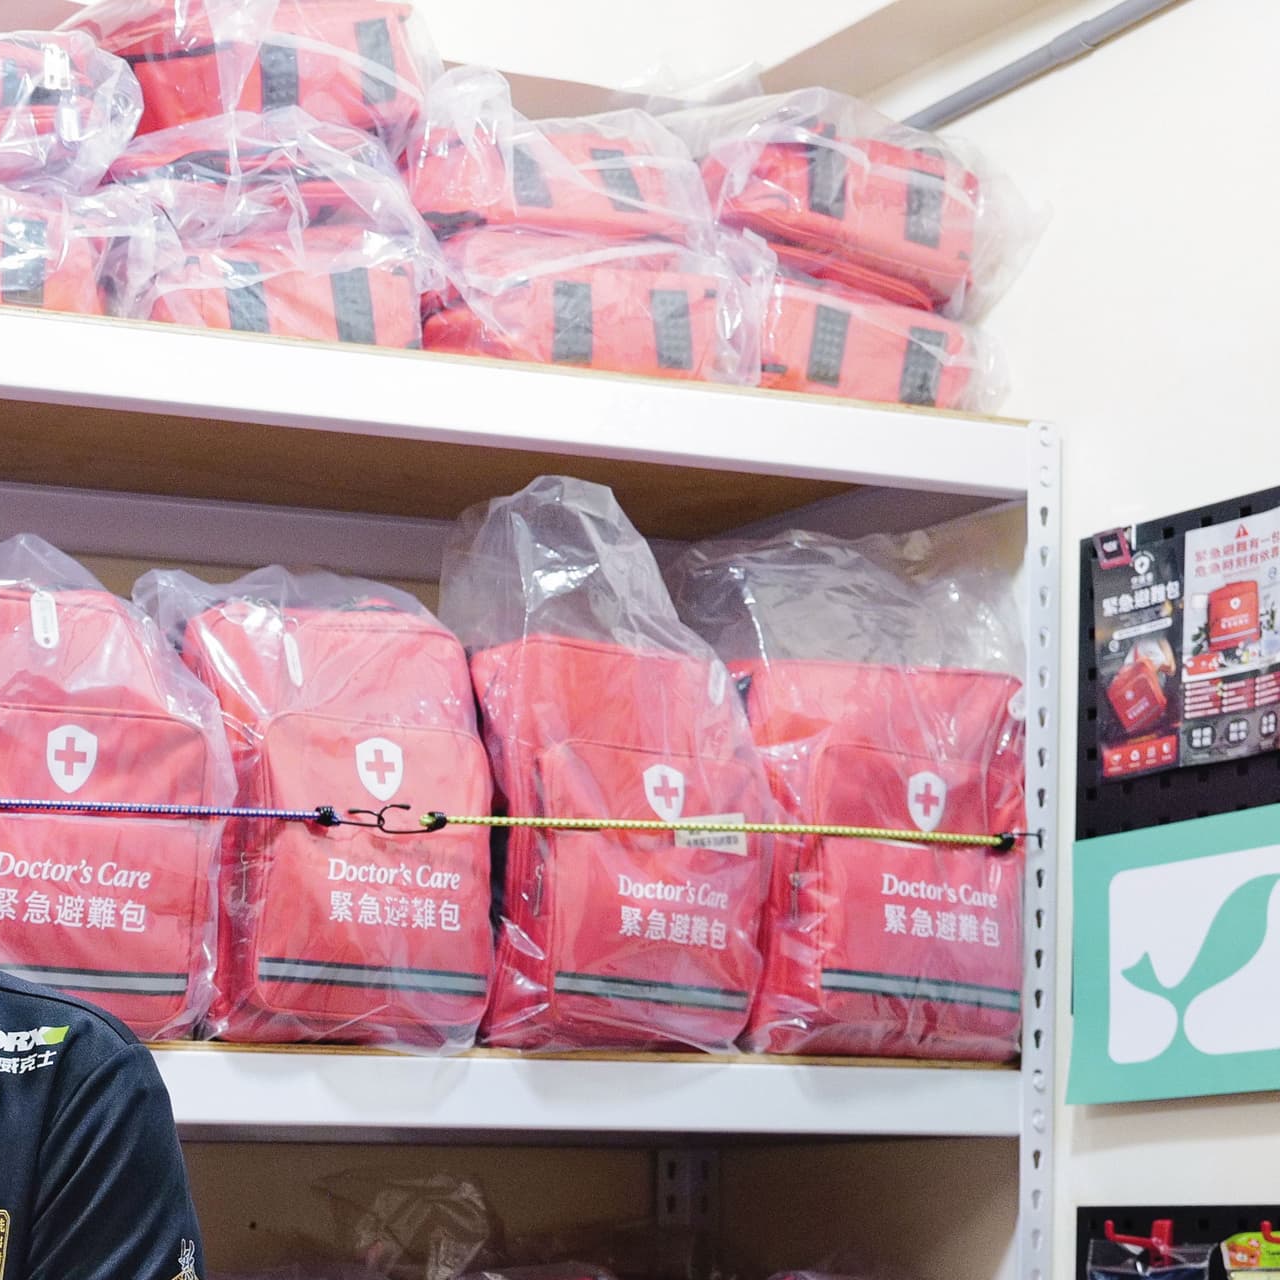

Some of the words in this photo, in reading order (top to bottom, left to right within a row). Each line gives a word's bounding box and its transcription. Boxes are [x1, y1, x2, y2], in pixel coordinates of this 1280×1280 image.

[98, 861, 152, 889] Care
[328, 858, 412, 885] Doctor's
[416, 865, 461, 889] Care
[881, 873, 955, 904] Doctor's
[959, 884, 998, 909] Care
[617, 874, 696, 904] Doctor's
[698, 884, 728, 909] Care
[619, 907, 727, 950] 緊急避難包
[883, 904, 1000, 946] 緊急避難包
